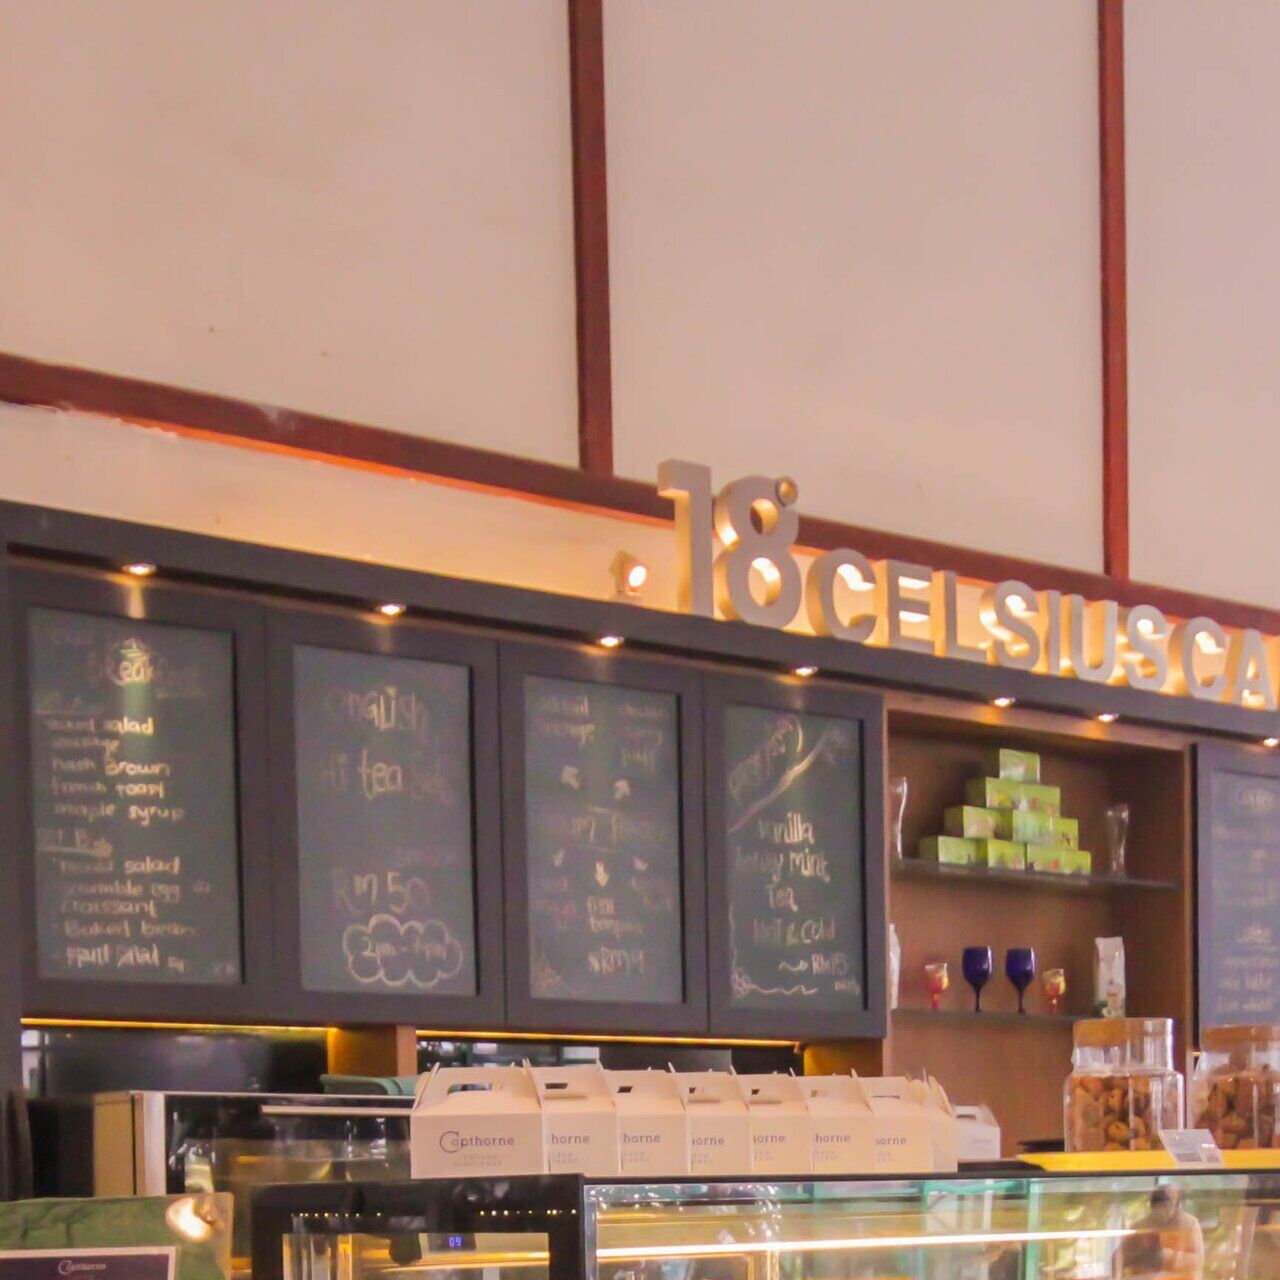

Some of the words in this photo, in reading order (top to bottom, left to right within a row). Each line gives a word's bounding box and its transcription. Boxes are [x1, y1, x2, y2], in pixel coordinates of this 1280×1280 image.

[806, 549, 1167, 691] CELSIUS
[358, 748, 404, 801] tea
[439, 1131, 515, 1154] Copthorne
